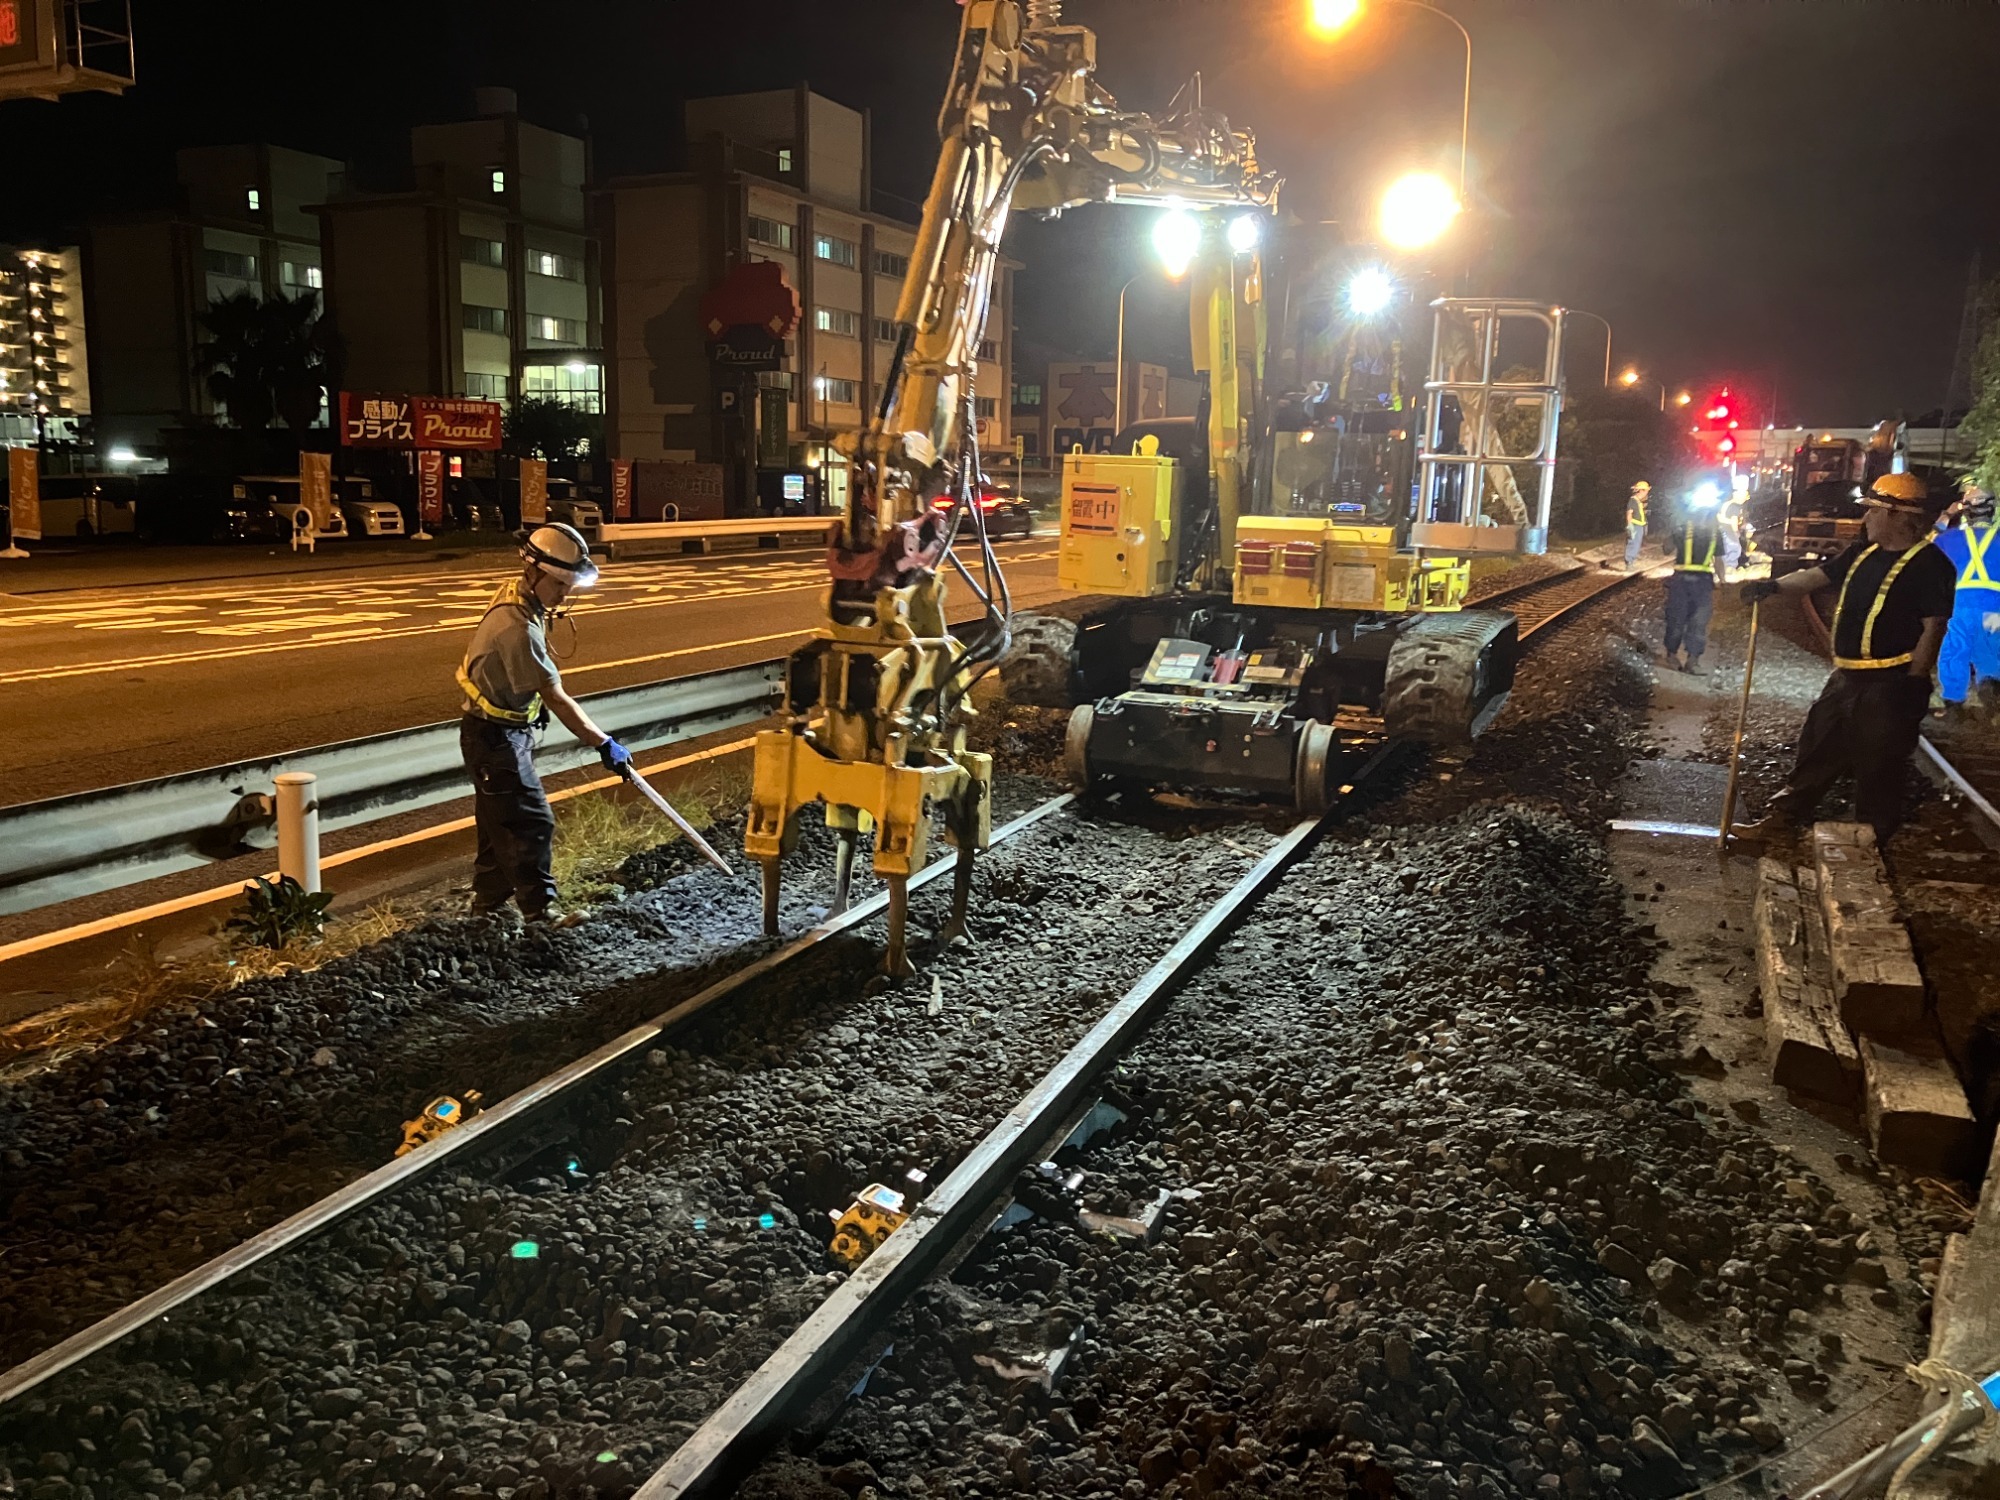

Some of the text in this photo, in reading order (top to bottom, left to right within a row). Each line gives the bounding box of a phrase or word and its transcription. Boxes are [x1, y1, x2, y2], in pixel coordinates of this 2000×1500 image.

[714, 343, 777, 361] Proud
[721, 391, 736, 410] P
[1057, 365, 1118, 427] 本
[347, 419, 415, 440] プライス
[423, 414, 494, 439] Proud
[424, 459, 441, 511] プラウド
[616, 466, 629, 508] プラウド
